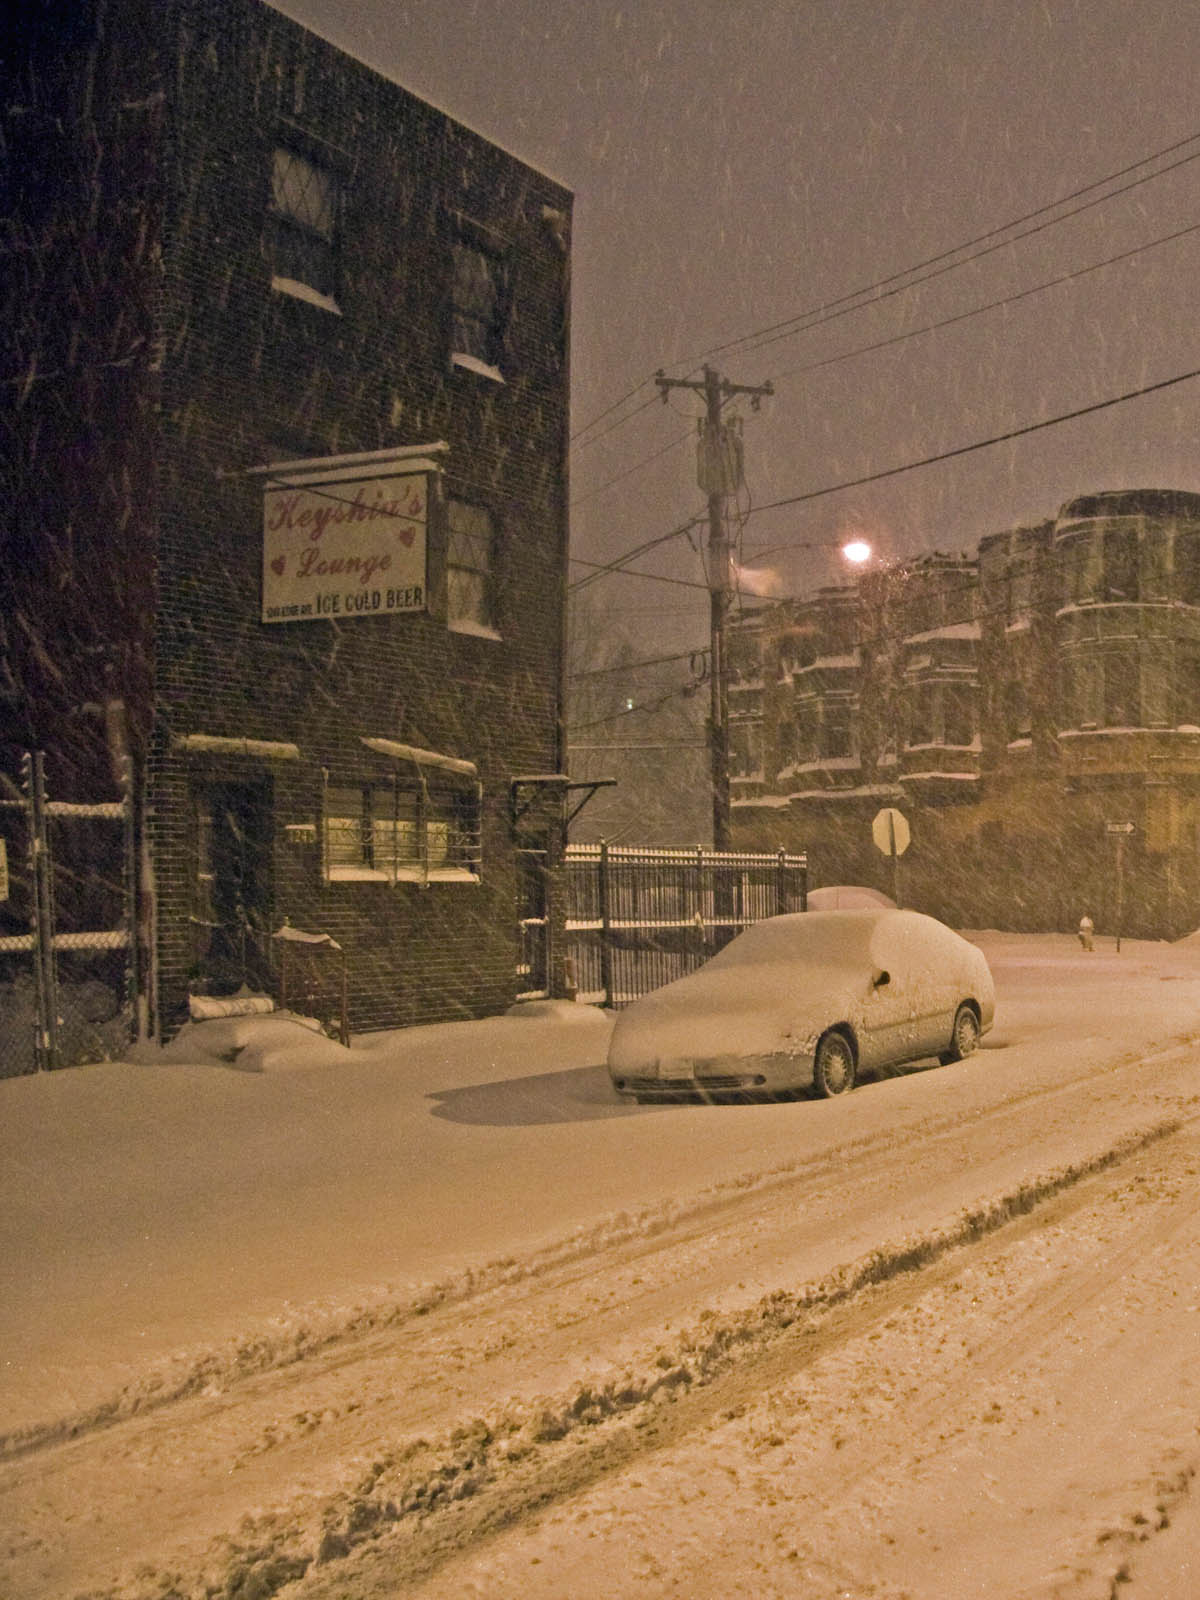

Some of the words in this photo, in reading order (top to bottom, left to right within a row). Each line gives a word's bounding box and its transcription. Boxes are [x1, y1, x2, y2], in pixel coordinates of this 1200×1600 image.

[297, 547, 391, 584] Lounge
[316, 590, 341, 614] ICE
[345, 588, 381, 610] COLD
[387, 586, 423, 609] BEER
